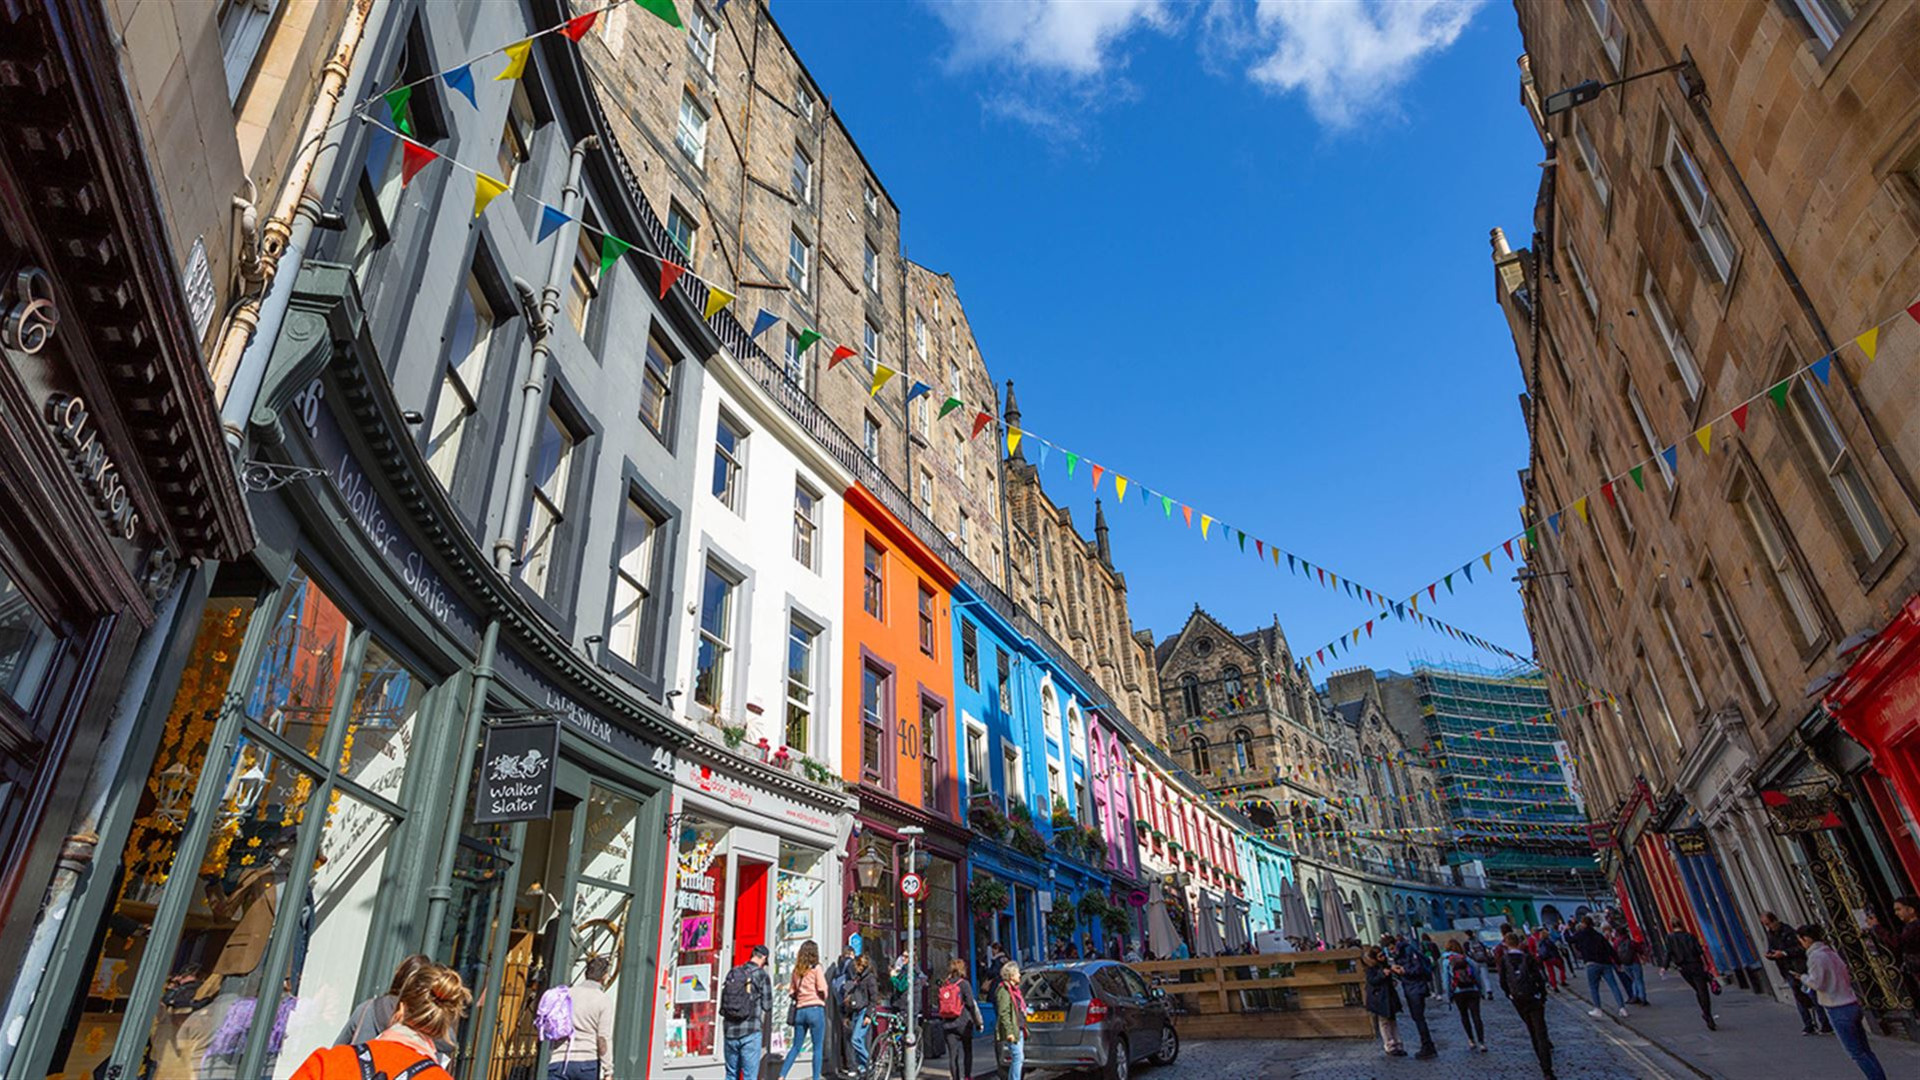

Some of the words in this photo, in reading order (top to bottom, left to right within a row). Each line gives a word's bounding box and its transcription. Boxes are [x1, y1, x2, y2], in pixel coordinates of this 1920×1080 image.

[64, 396, 139, 540] CLARKSONS
[338, 454, 397, 556] Walker
[402, 551, 456, 624] Slater
[896, 719, 918, 760] 40
[711, 778, 727, 794] door
[729, 786, 753, 806] gallery
[903, 879, 919, 891] 20
